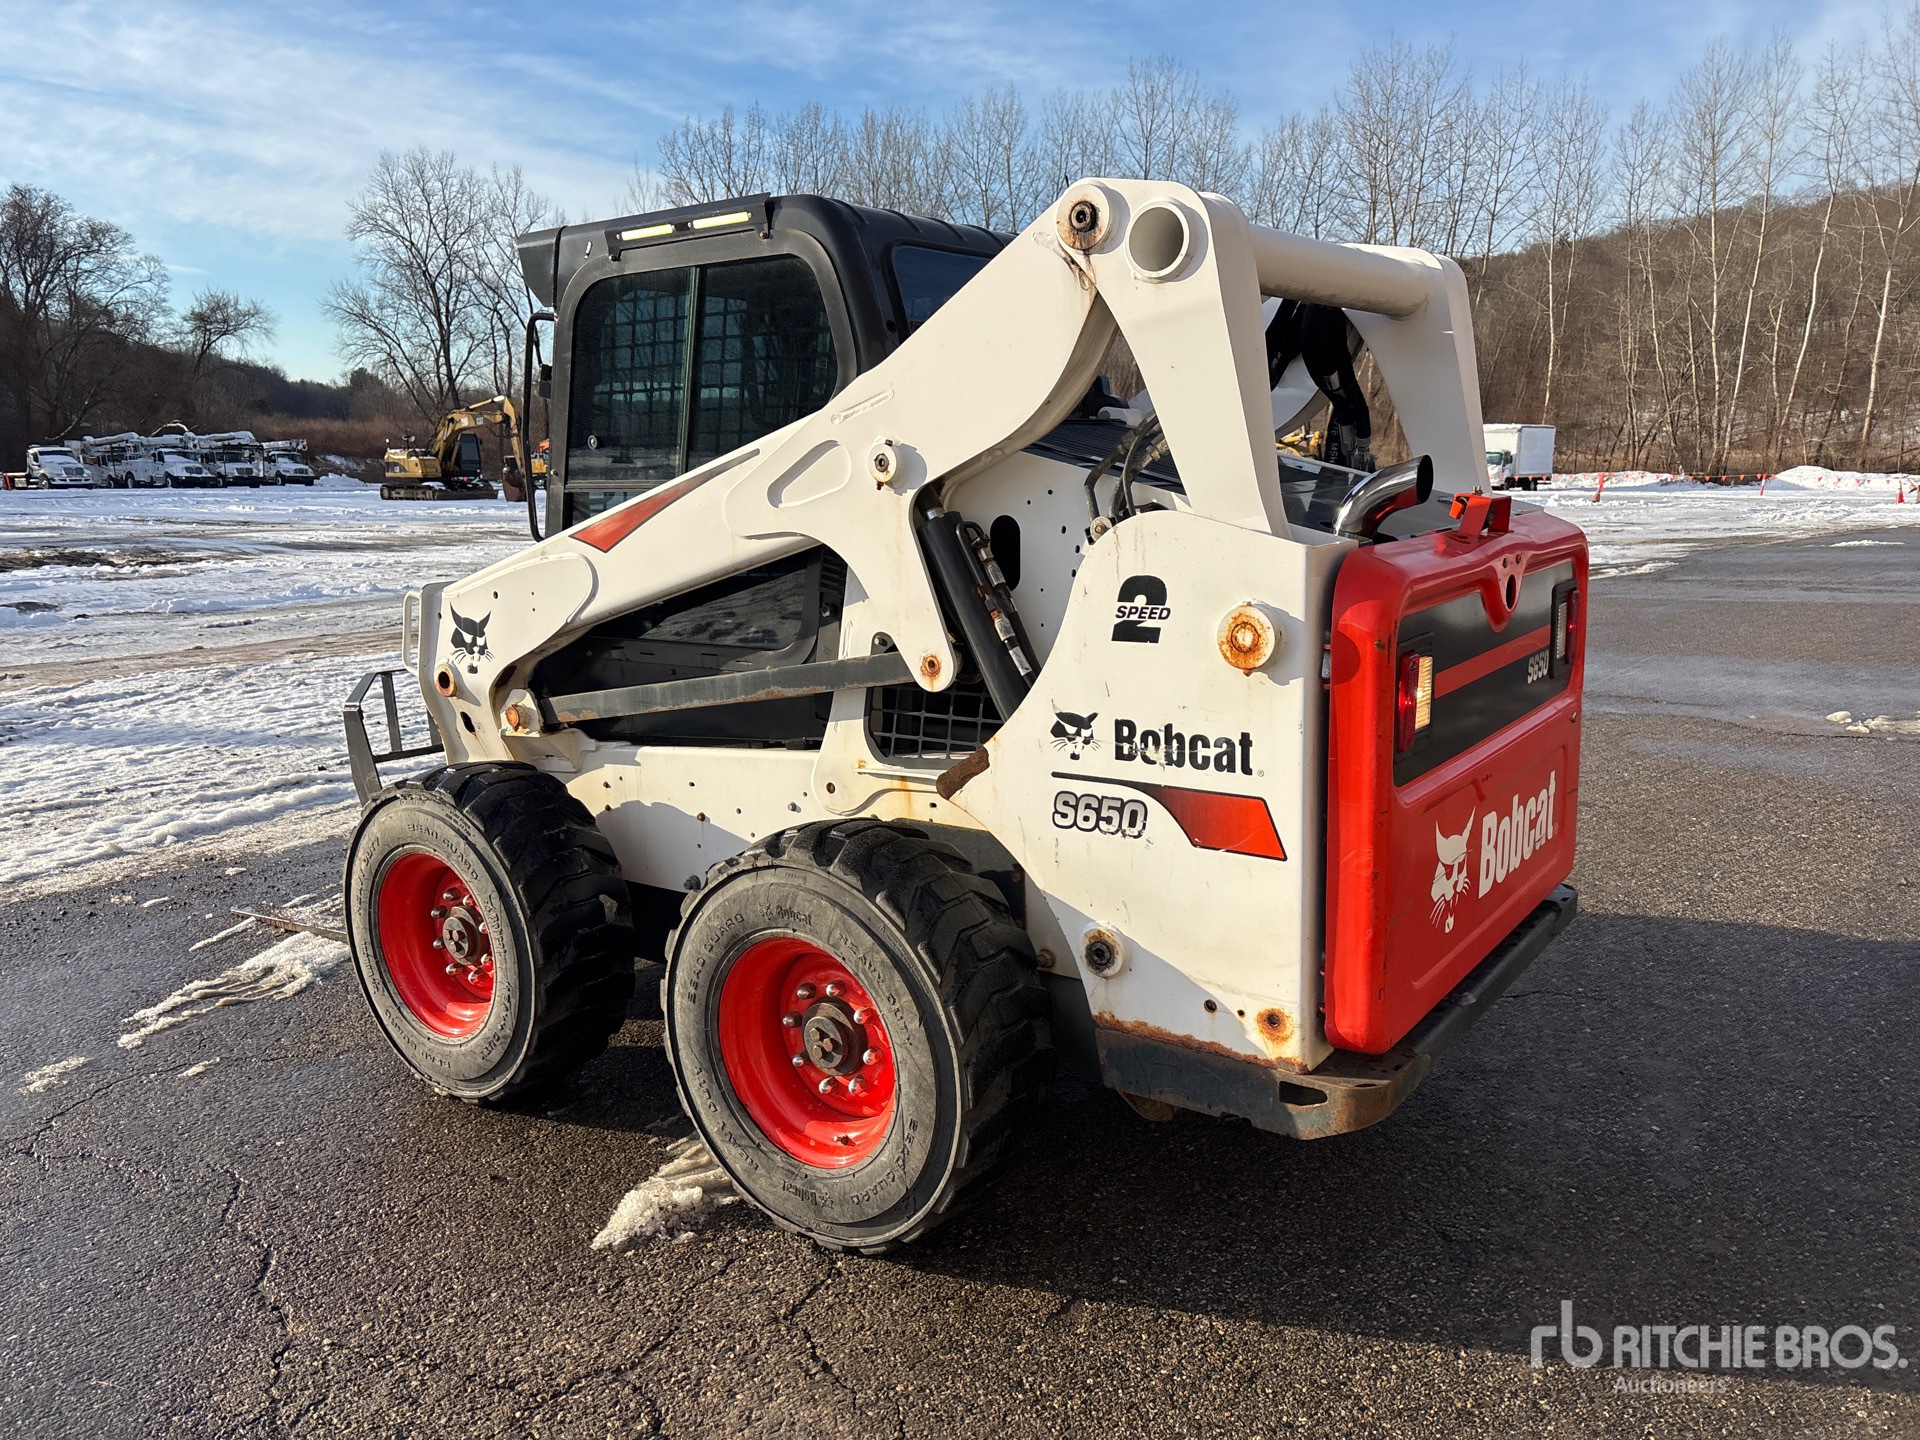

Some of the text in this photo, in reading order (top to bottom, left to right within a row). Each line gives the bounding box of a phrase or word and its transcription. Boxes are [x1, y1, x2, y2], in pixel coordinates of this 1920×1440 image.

[1111, 575, 1168, 644] 2
[1115, 605, 1171, 621] SPEED
[1527, 649, 1549, 684] S650
[1114, 718, 1253, 776] Bobcat
[1052, 790, 1148, 839] S650
[1478, 770, 1557, 899] Bobcat
[442, 838, 479, 880] GUARD
[703, 913, 745, 953] GUARD
[849, 1170, 896, 1206] GUARD
